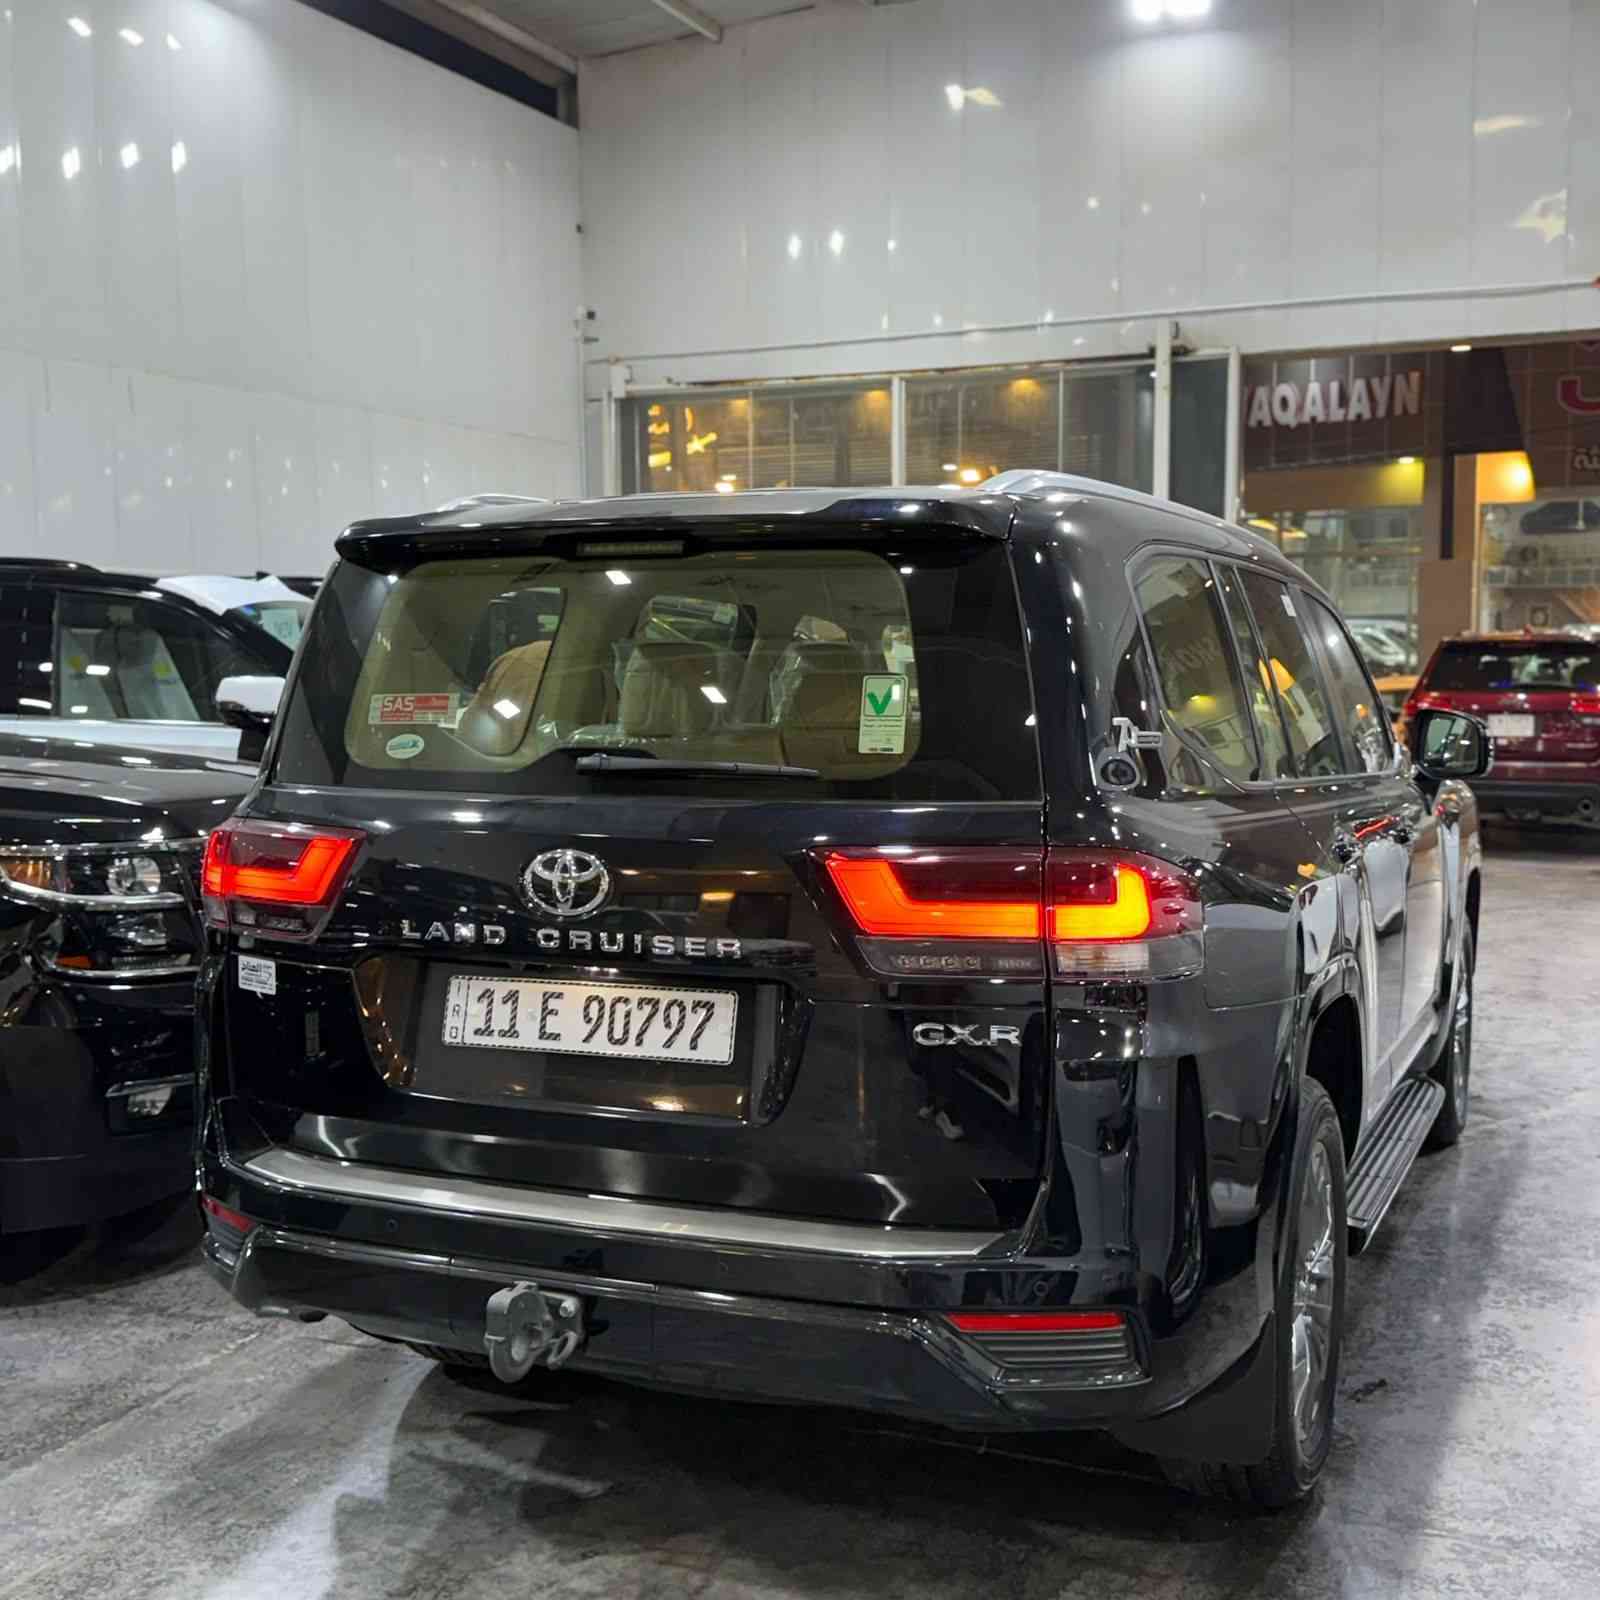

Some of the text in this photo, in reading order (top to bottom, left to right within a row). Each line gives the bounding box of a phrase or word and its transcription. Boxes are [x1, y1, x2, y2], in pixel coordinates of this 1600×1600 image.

[383, 696, 416, 711] SAS
[401, 919, 742, 959] LAND CRUISER
[474, 987, 716, 1051] 11 E 90797
[912, 1022, 1022, 1047] GXR
